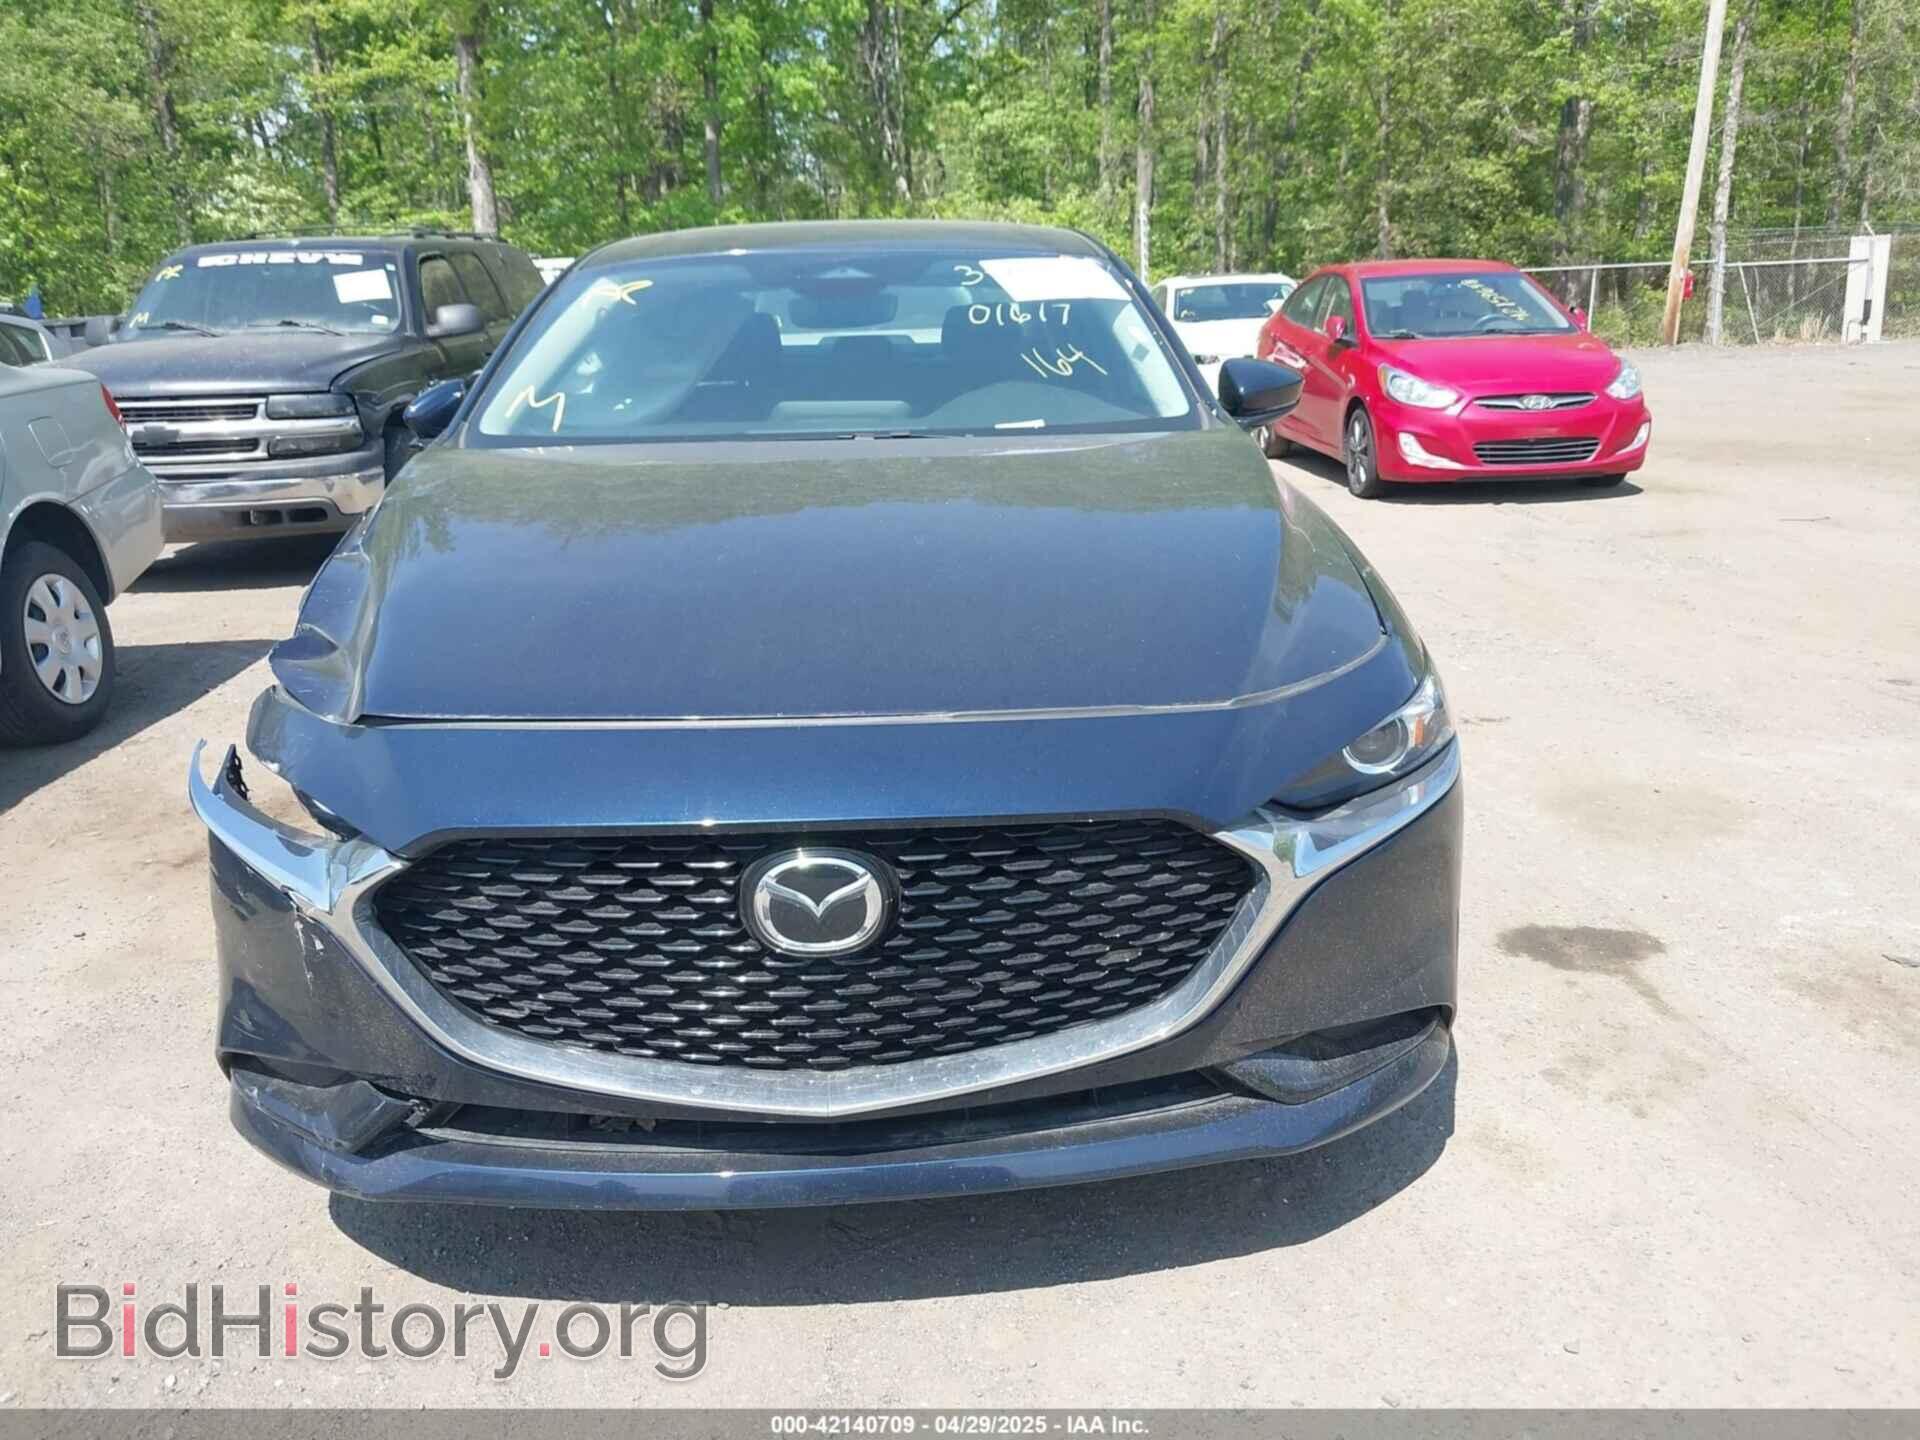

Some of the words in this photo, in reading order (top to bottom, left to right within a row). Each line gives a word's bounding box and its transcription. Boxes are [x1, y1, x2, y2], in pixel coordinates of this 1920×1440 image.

[953, 265, 984, 286] 3
[968, 302, 1071, 326] 01617
[1020, 343, 1108, 378] 164
